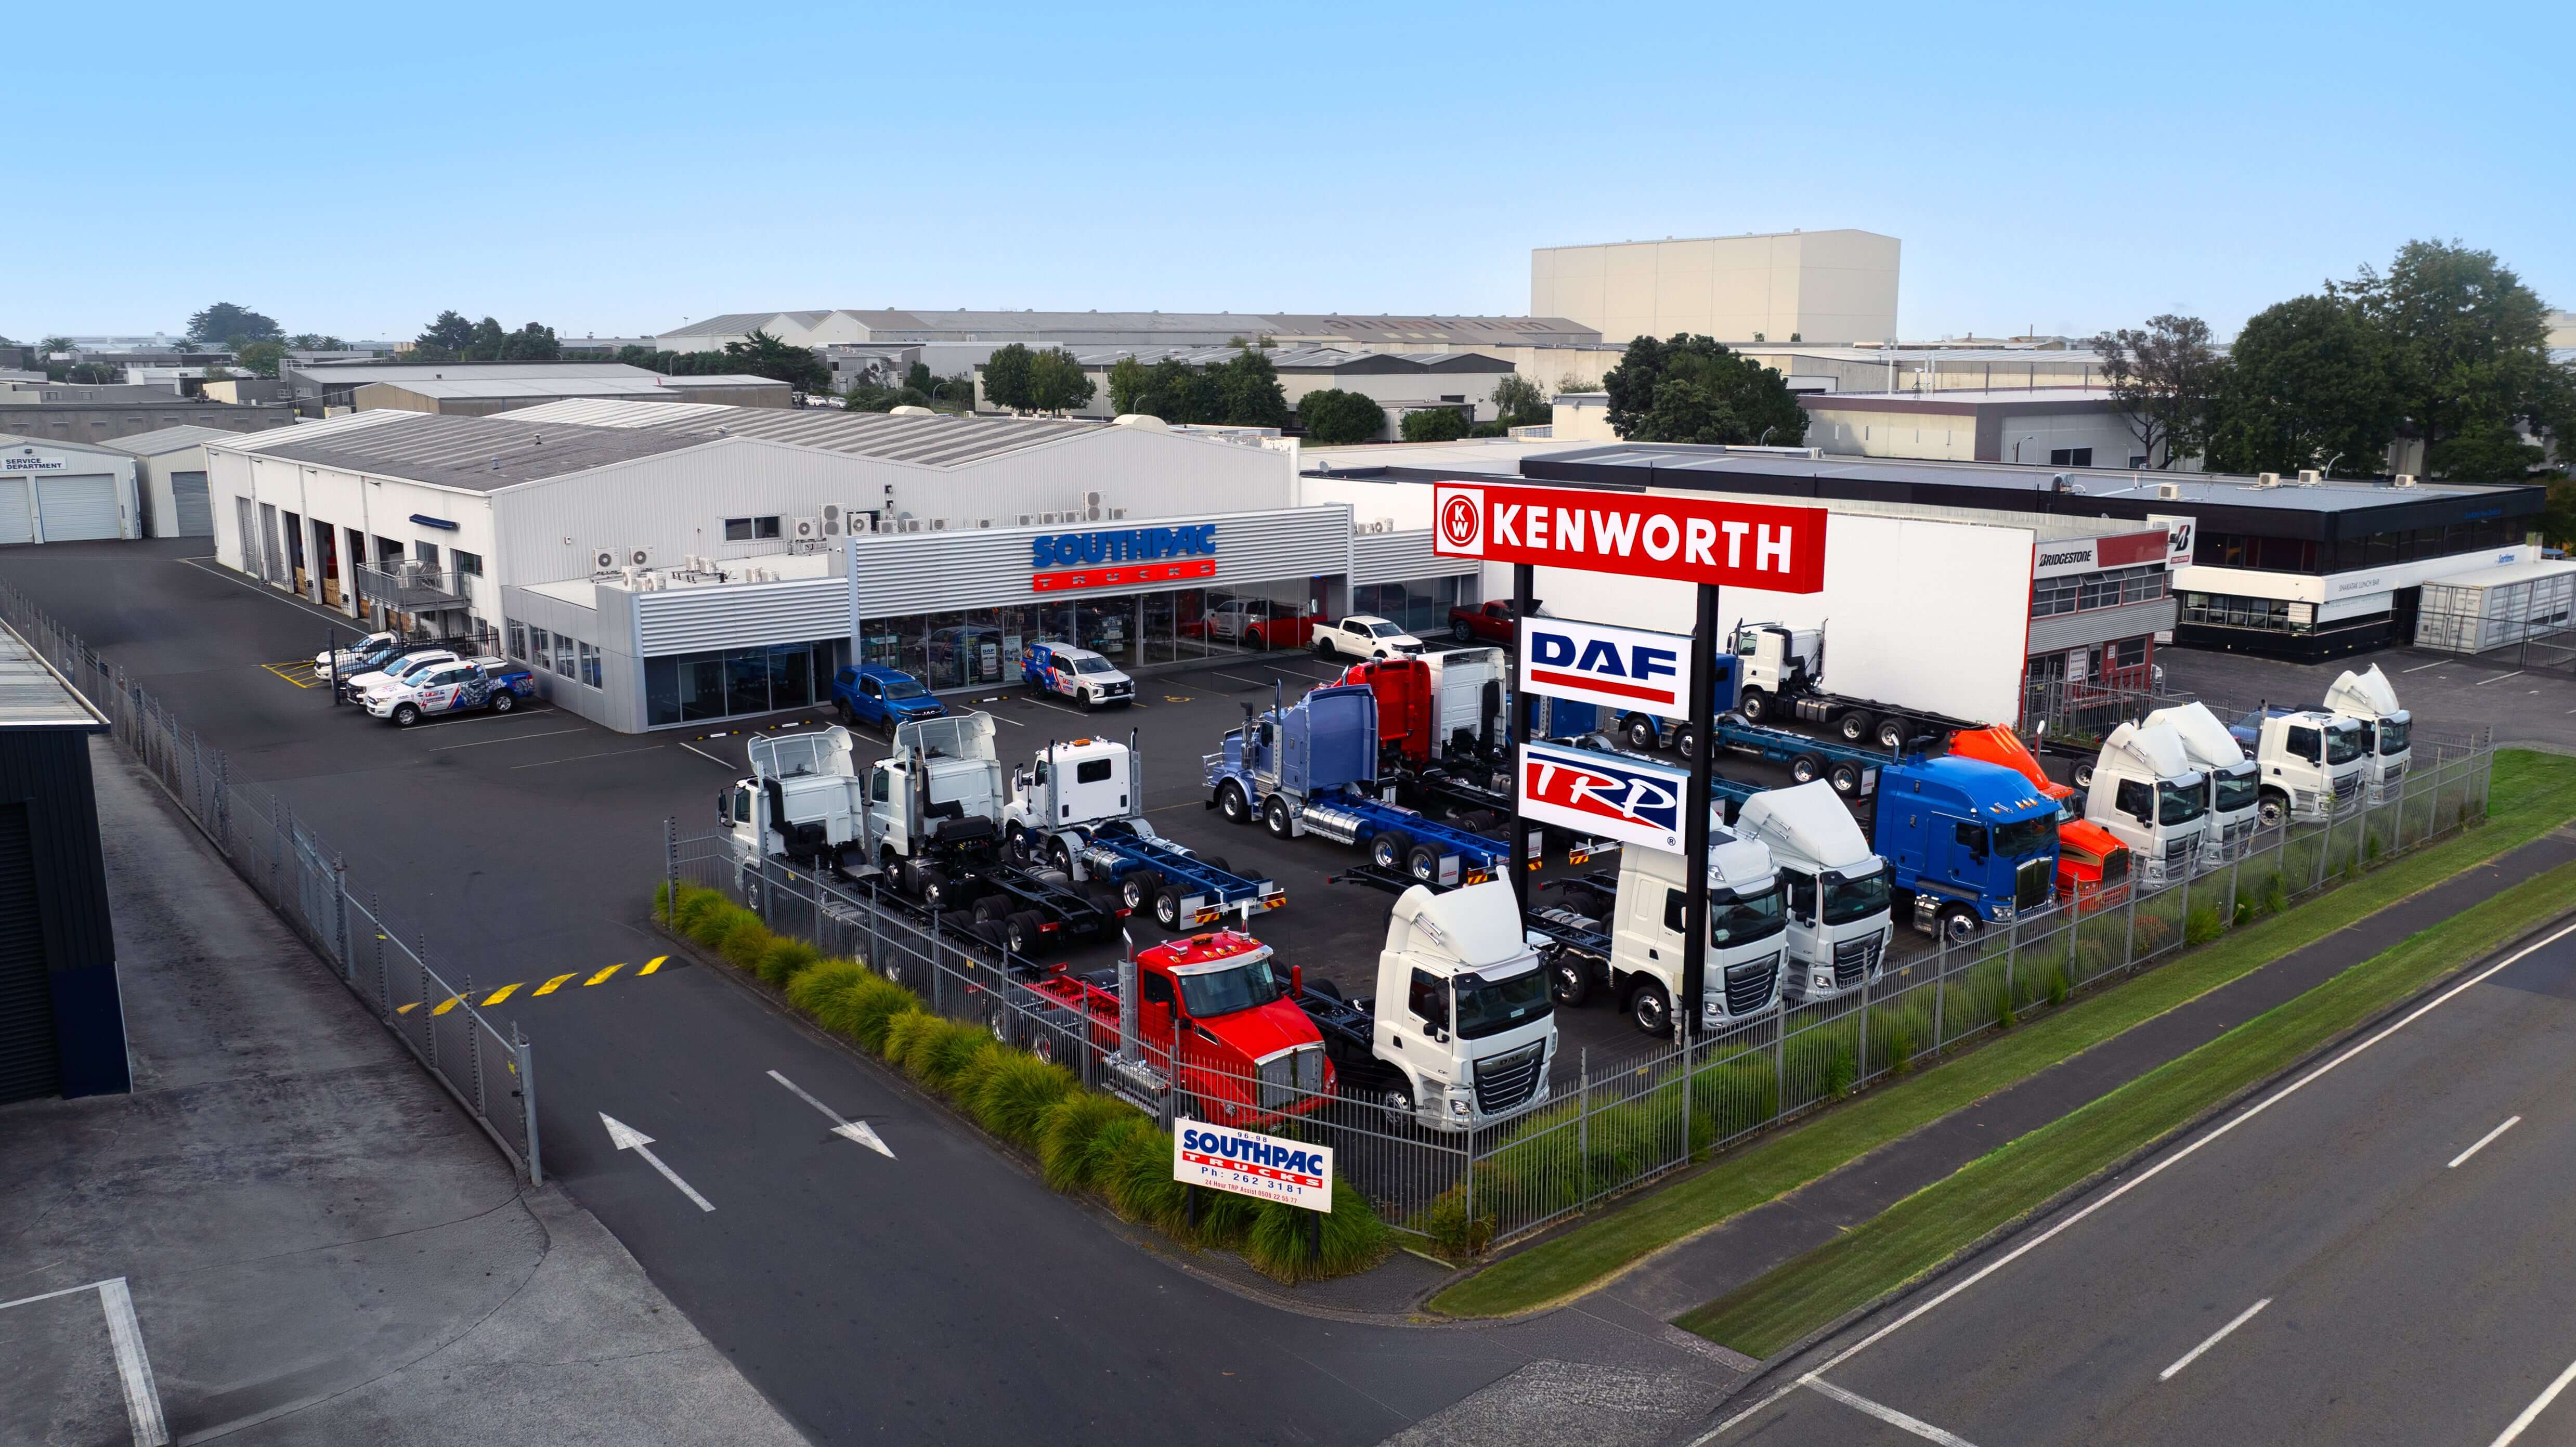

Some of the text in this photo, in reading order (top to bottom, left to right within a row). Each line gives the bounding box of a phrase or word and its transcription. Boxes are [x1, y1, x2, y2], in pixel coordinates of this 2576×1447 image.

[1032, 524, 1215, 568] SOUTHPAC
[1493, 503, 1792, 573] KENWORTH
[2038, 550, 2092, 567] BRIDGESTONE
[1038, 564, 1212, 588] TRUCKS
[2359, 580, 2372, 589] LUNCH
[1531, 631, 1677, 680] DAF
[1527, 758, 1676, 818] TRP
[1500, 1053, 1523, 1065] DAF
[1237, 1131, 1267, 1143] 96-98
[1183, 1129, 1323, 1176] SOUTHPAC
[1185, 1153, 1320, 1187] TRUCKS
[1201, 1167, 1302, 1195] Ph: 262 3181
[1240, 1186, 1257, 1195] Assist
[1258, 1190, 1271, 1198] 0508
